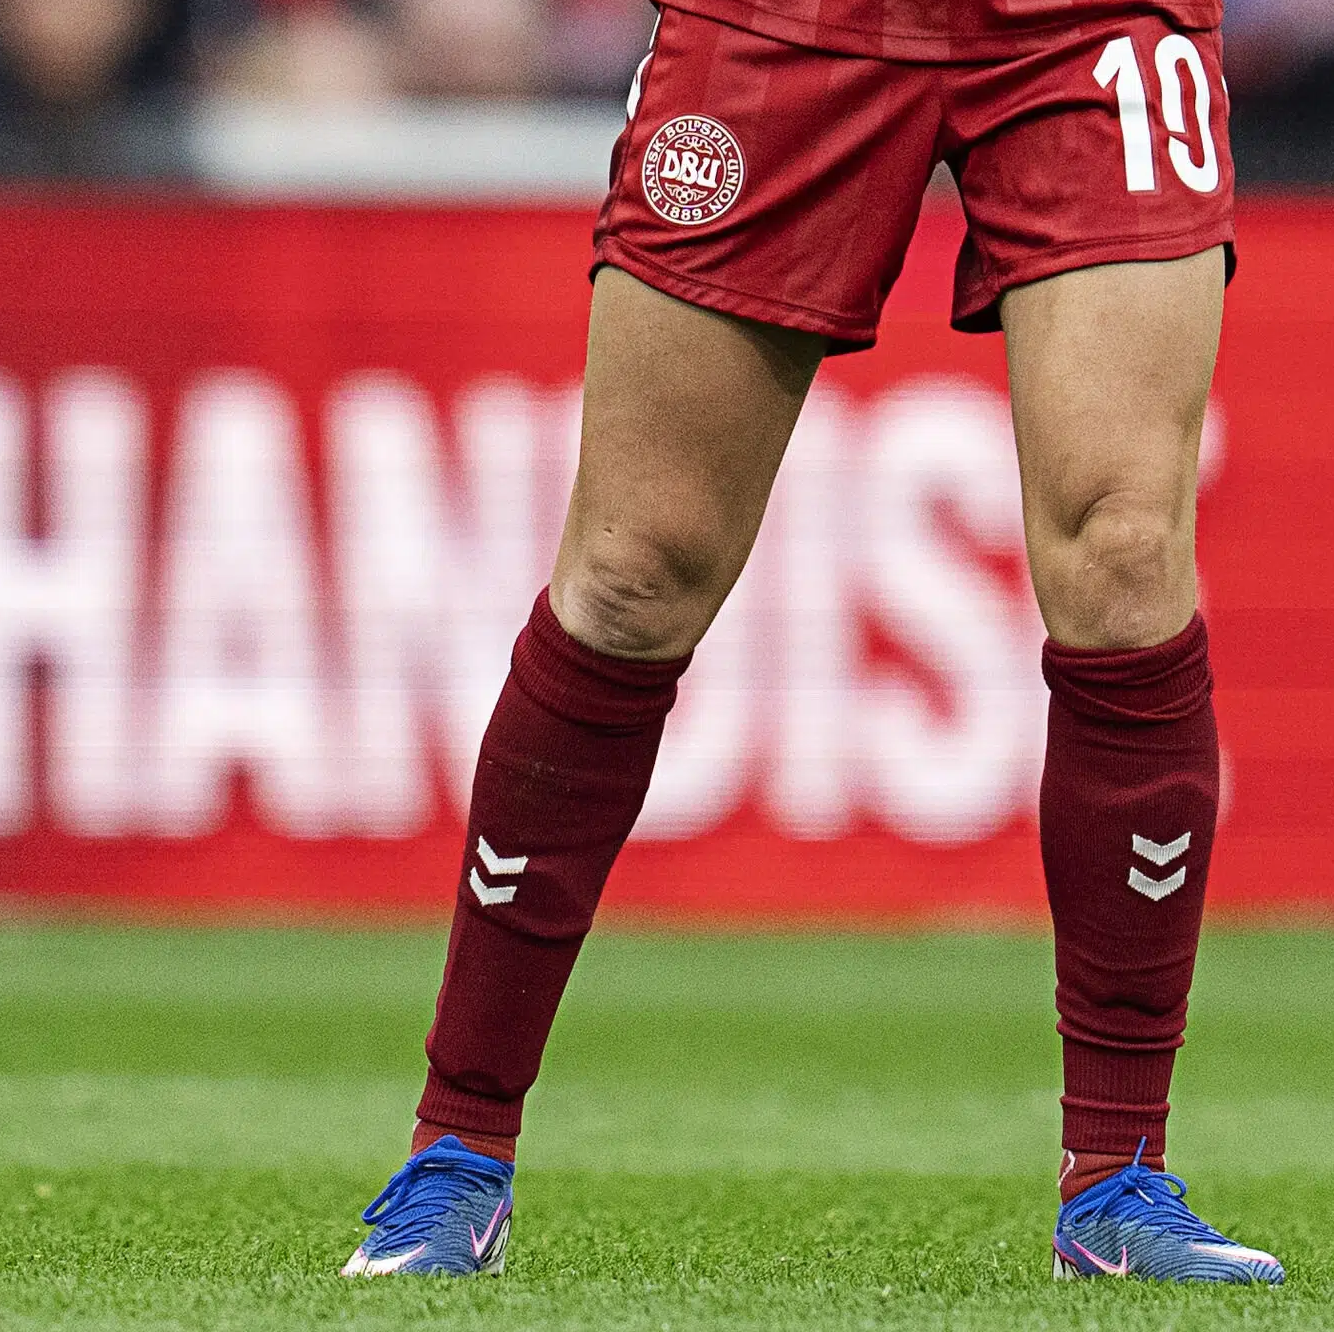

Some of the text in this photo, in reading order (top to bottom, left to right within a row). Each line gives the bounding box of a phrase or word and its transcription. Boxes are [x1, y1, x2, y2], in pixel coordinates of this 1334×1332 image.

[1092, 33, 1220, 194] 10
[645, 139, 665, 203] DANSK
[659, 149, 721, 188] DBU
[662, 202, 703, 221] 1889
